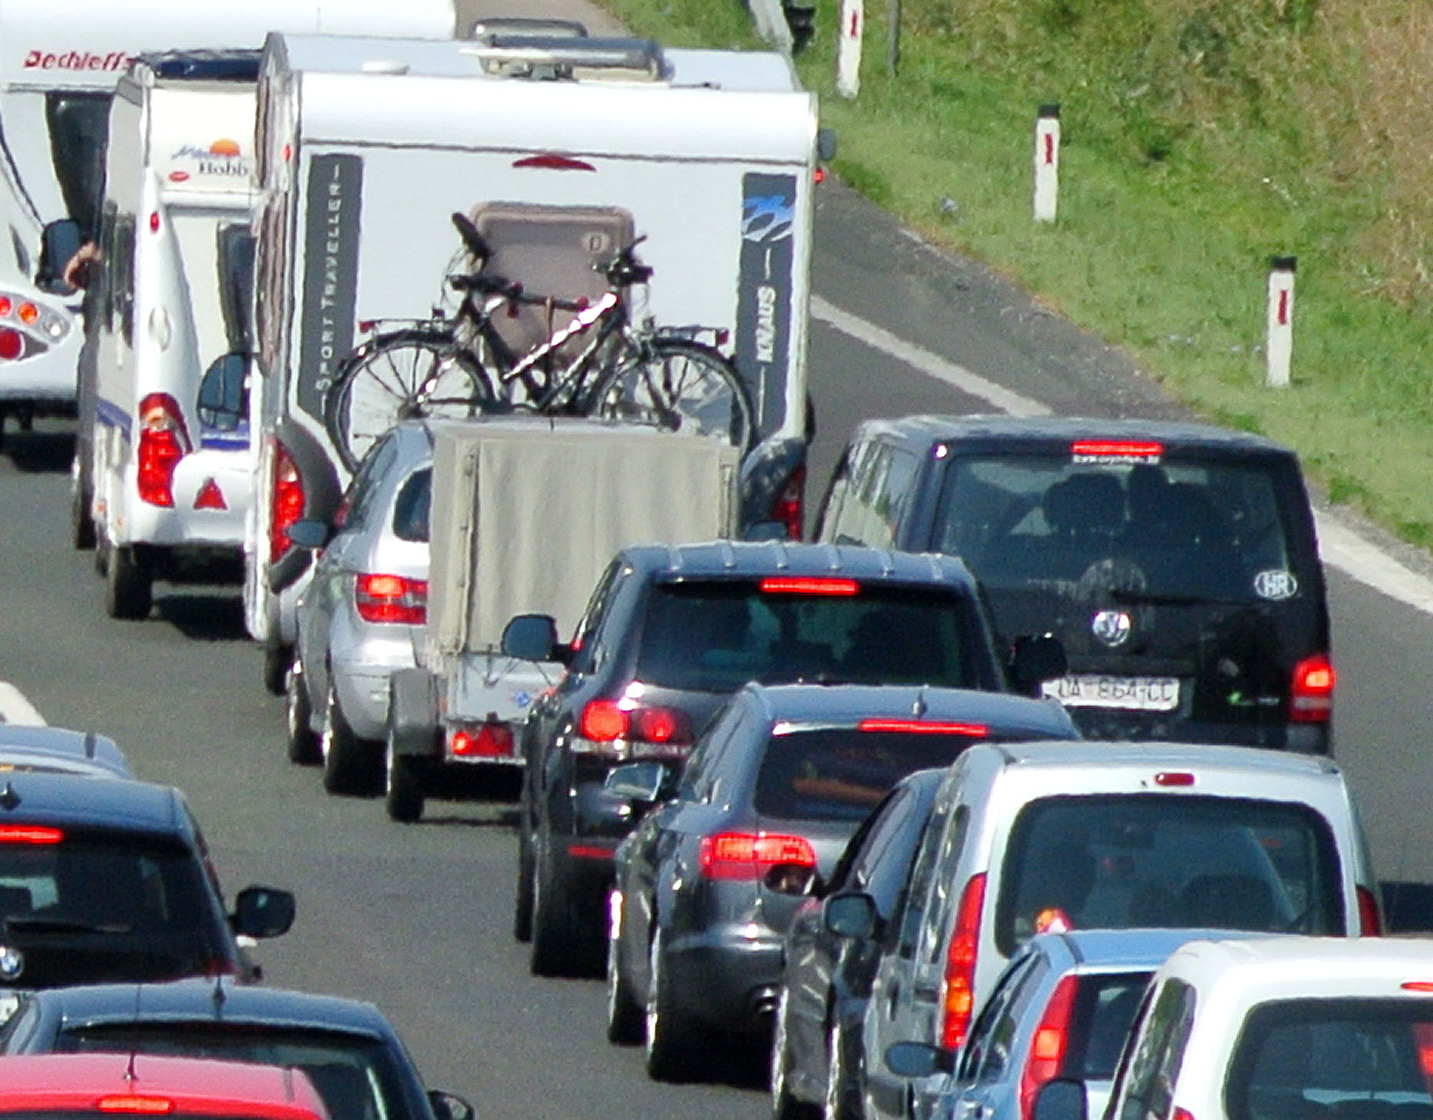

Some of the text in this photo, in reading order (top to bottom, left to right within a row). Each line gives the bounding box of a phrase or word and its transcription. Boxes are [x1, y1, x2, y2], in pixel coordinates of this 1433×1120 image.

[198, 161, 250, 176] Hobb
[755, 286, 776, 362] KNAUS
[1264, 573, 1289, 598] HR
